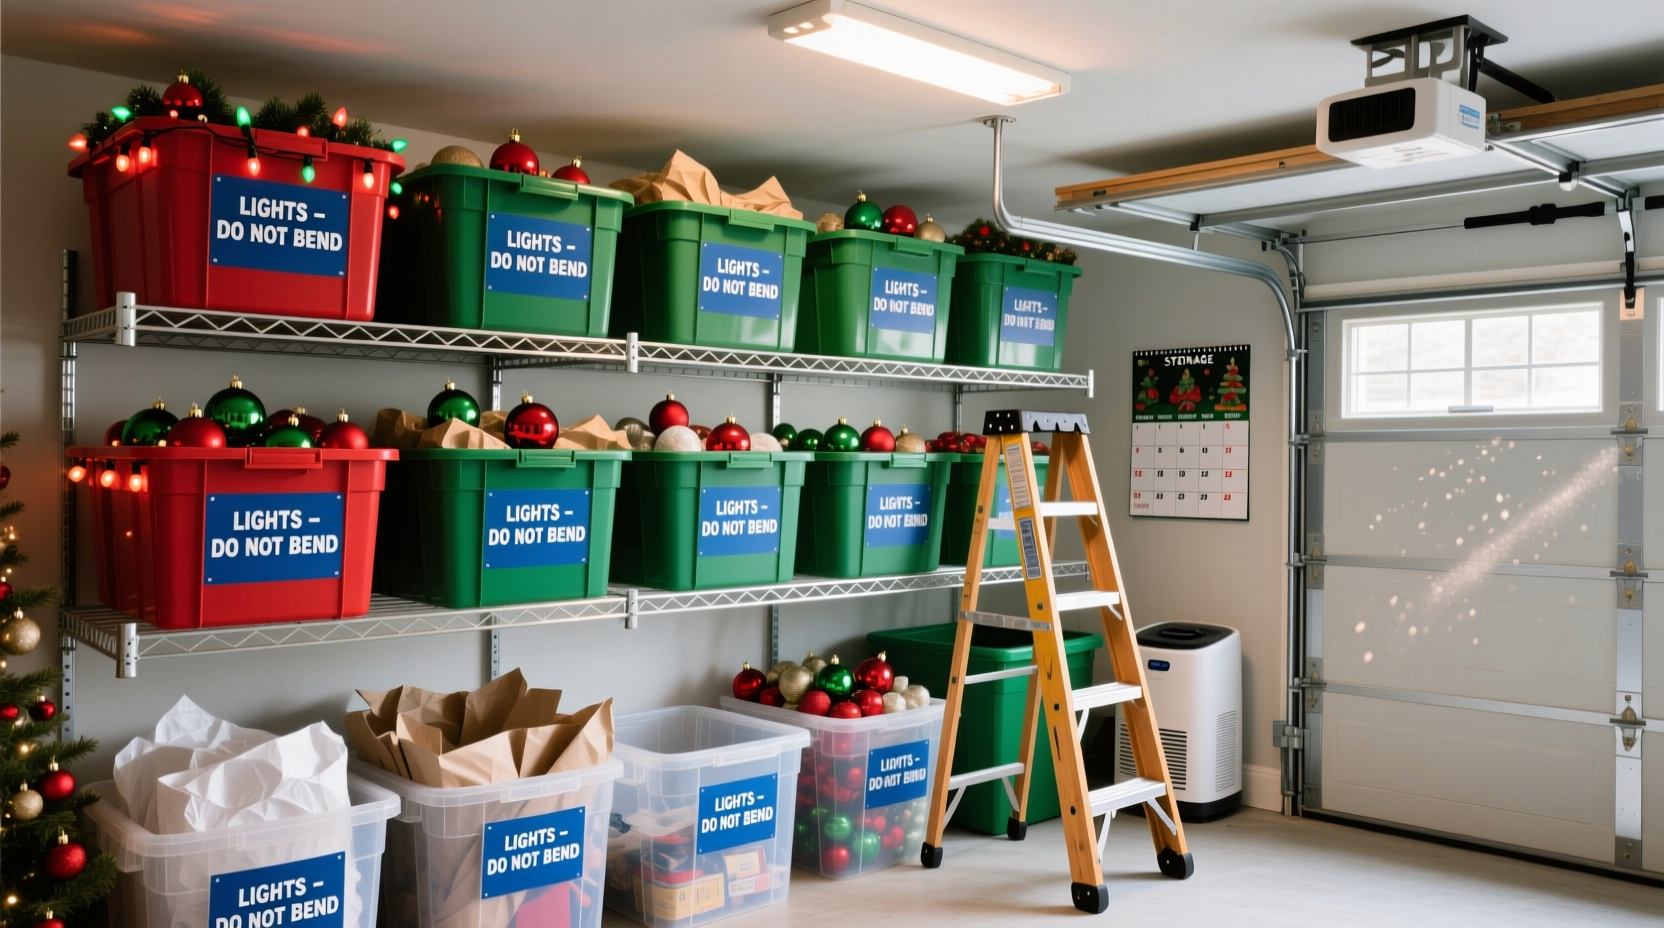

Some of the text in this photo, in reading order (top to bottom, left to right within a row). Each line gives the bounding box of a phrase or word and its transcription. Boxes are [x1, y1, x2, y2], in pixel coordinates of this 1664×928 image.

[240, 196, 307, 222] LIGHTS
[217, 220, 342, 251] DO NOT BEND
[508, 230, 561, 253] LIGHTS
[491, 252, 587, 277] DO NOT BEND
[718, 258, 759, 277] LIGHTS
[703, 276, 778, 299] DO NOT BEND
[874, 297, 887, 311] DO
[507, 504, 560, 522] LIGHTS
[717, 500, 758, 515] LIGHTS
[234, 510, 302, 530] LIGHTS
[702, 519, 777, 536] DO NOT BEND
[868, 515, 883, 529] DO
[212, 535, 338, 557] DO NOT BEND
[489, 526, 585, 545] DO NOT BEND
[869, 777, 882, 791] DO
[715, 792, 754, 811] LIGHTS
[702, 807, 773, 833] DO NOT BEND
[505, 828, 555, 851] LIGHTS
[488, 843, 579, 875] DO NOT BEND
[239, 878, 306, 907] LIGHTS
[249, 906, 285, 928] NOT
[291, 896, 339, 922] BEND
